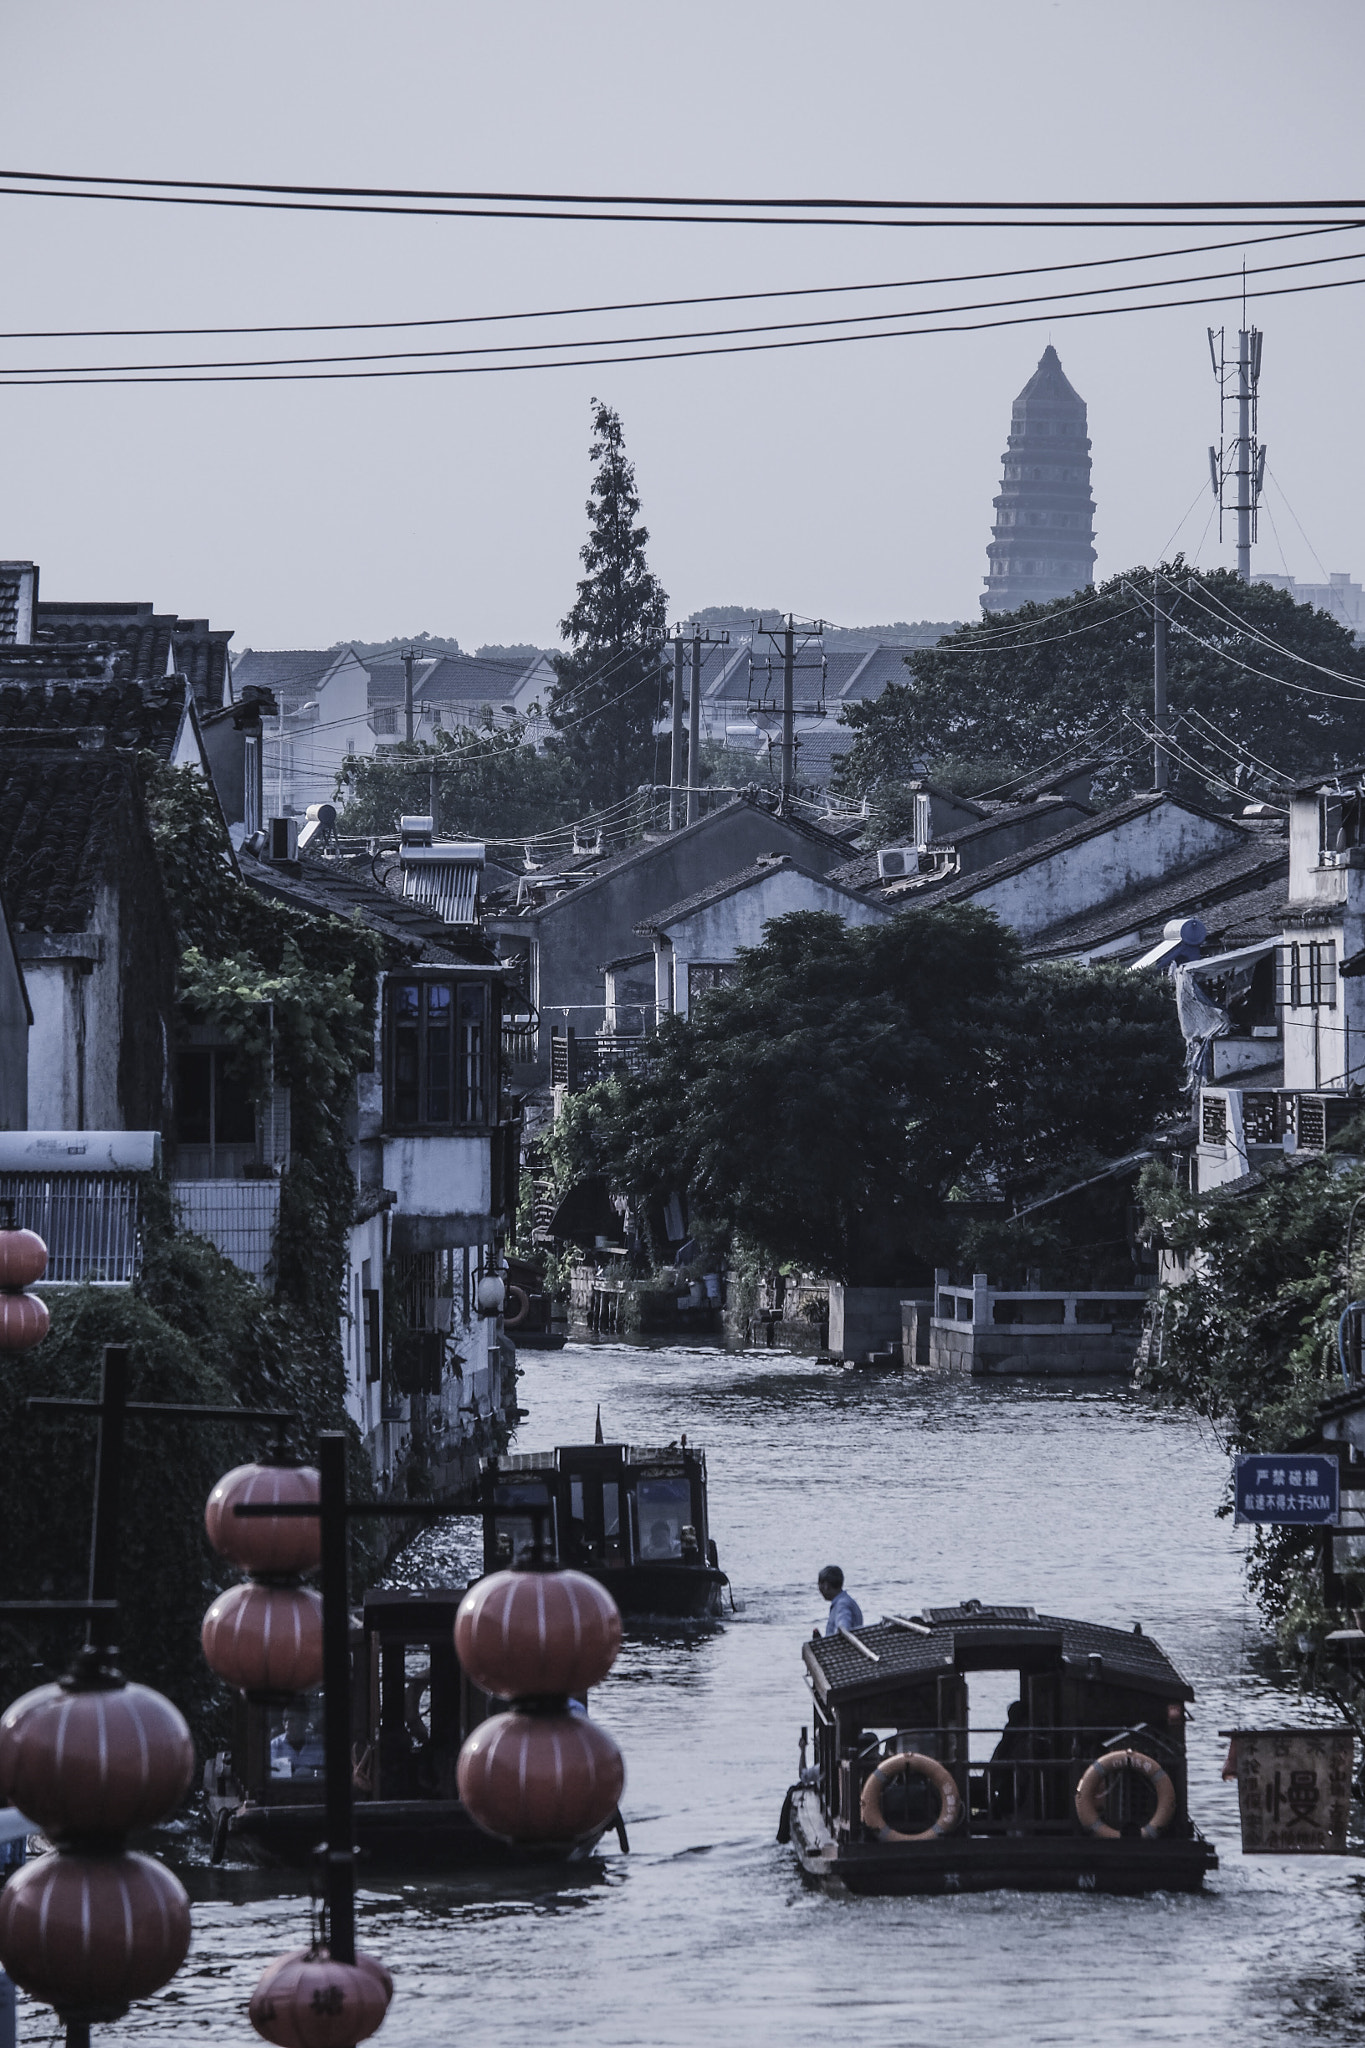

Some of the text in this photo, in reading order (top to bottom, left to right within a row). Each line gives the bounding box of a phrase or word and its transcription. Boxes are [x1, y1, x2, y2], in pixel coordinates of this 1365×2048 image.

[1256, 1469, 1319, 1487] 严禁碰撞
[1266, 1771, 1322, 1828] 慢
